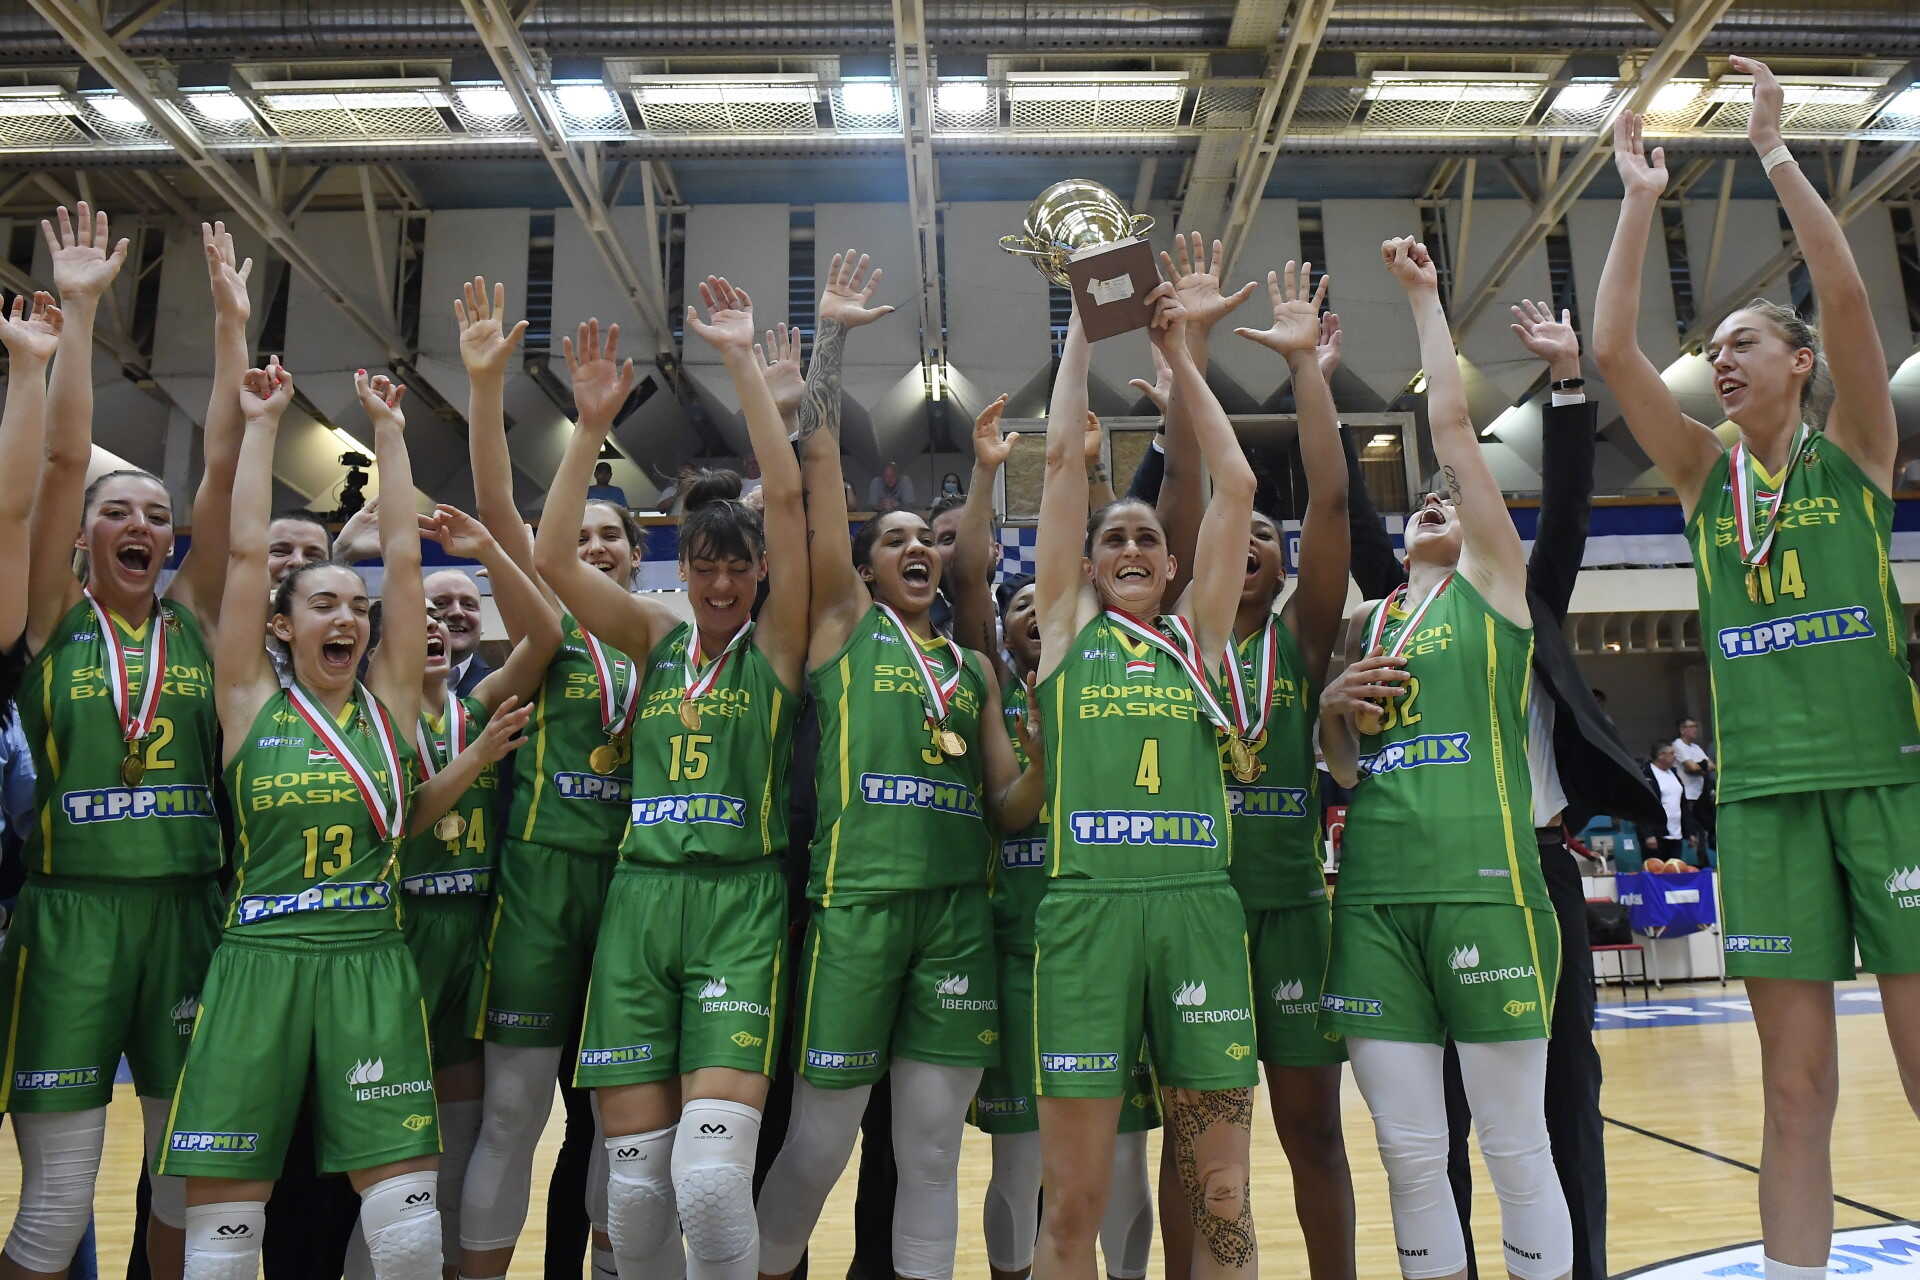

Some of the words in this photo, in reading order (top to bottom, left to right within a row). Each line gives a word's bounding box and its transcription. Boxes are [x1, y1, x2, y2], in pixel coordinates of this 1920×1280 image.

[1759, 549, 1806, 605] 14
[1080, 703, 1199, 722] BASKET
[669, 735, 713, 781] 15
[1135, 739, 1161, 794] 4
[1074, 814, 1215, 843] TiPPMIX
[303, 825, 353, 879] 13
[1459, 966, 1535, 984] IBERDROLA
[702, 1000, 771, 1017] IBERDROLA
[1182, 1009, 1250, 1023] IBERDROLA
[356, 1079, 432, 1101] IBERDROLA
[173, 1133, 256, 1150] TiPPMIX
